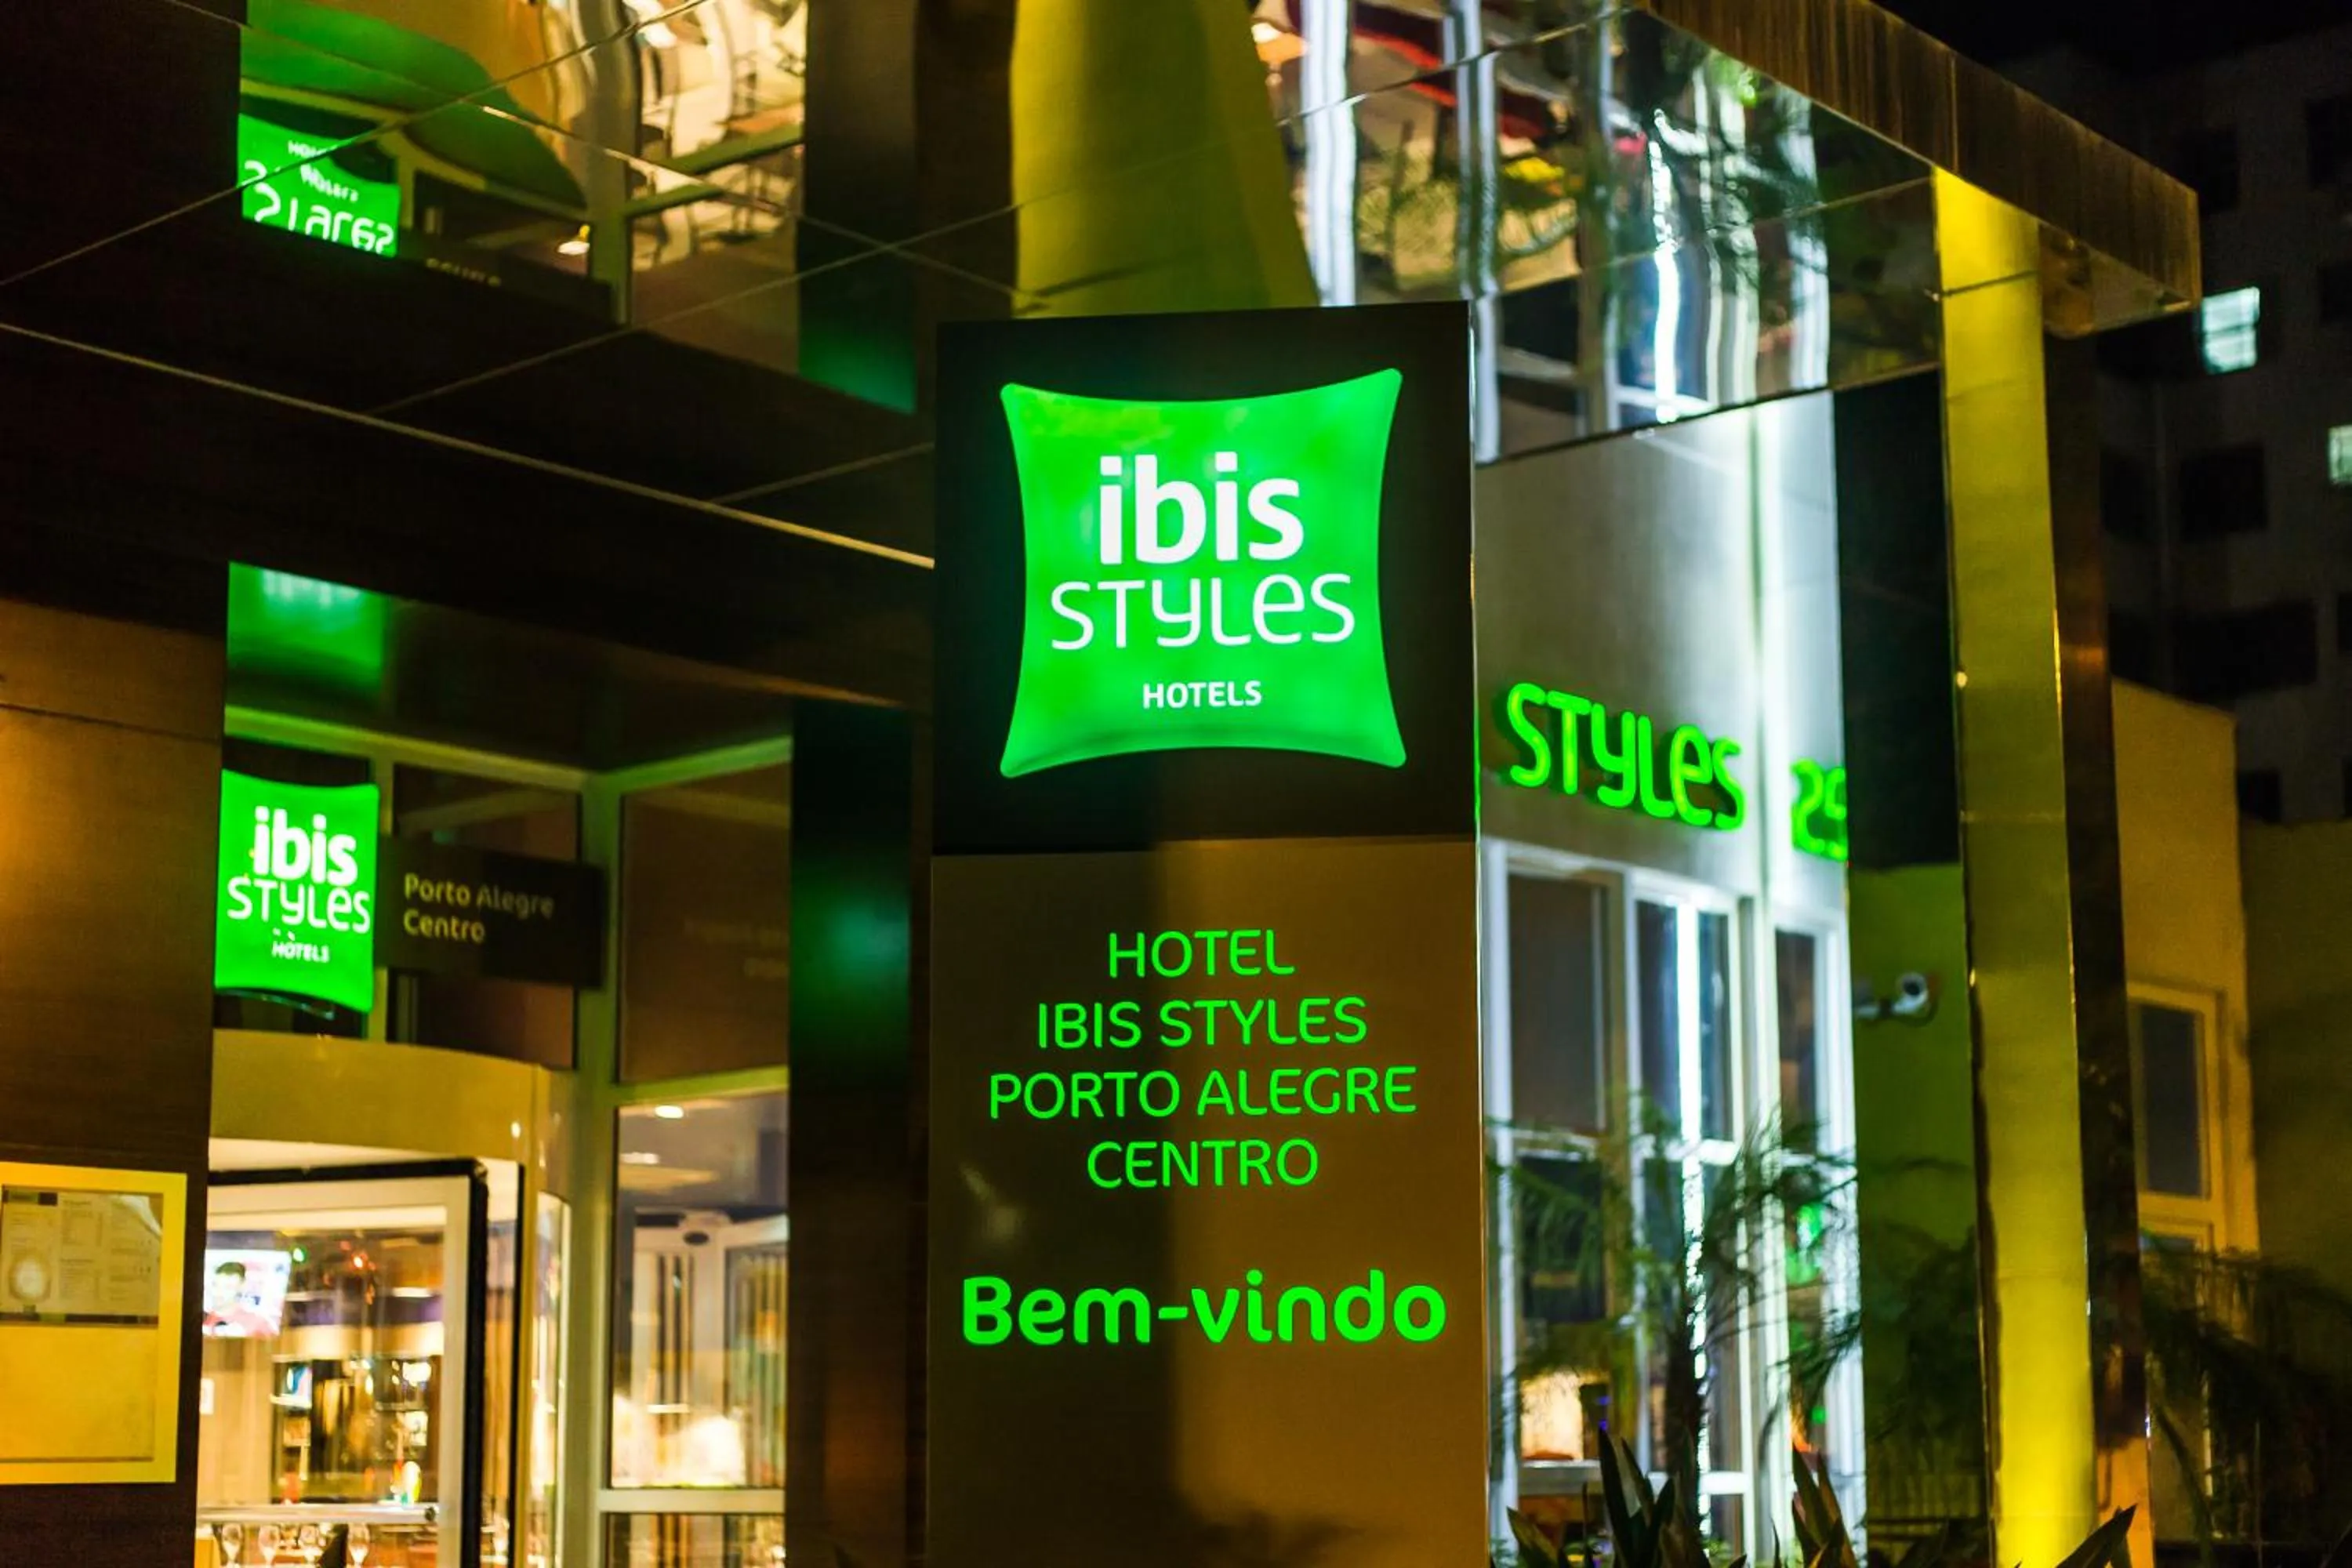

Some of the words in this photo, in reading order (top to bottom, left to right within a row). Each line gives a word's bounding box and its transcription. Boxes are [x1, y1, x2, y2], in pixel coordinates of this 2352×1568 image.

[1099, 451, 1305, 564] ibis
[1142, 680, 1263, 709] HOTELS
[253, 805, 359, 887] ibis
[405, 873, 470, 906] Porto
[476, 884, 554, 920] Alegre
[403, 908, 486, 943] Centro
[1109, 928, 1296, 978] HOTEL
[1038, 1000, 1142, 1049] IBIS
[1159, 996, 1368, 1047] STYLES
[989, 1070, 1181, 1120] PORTO
[1196, 1065, 1417, 1116] ALEGRE
[1087, 1138, 1319, 1189] CENTRO
[963, 1268, 1447, 1345] Bem-vindo
